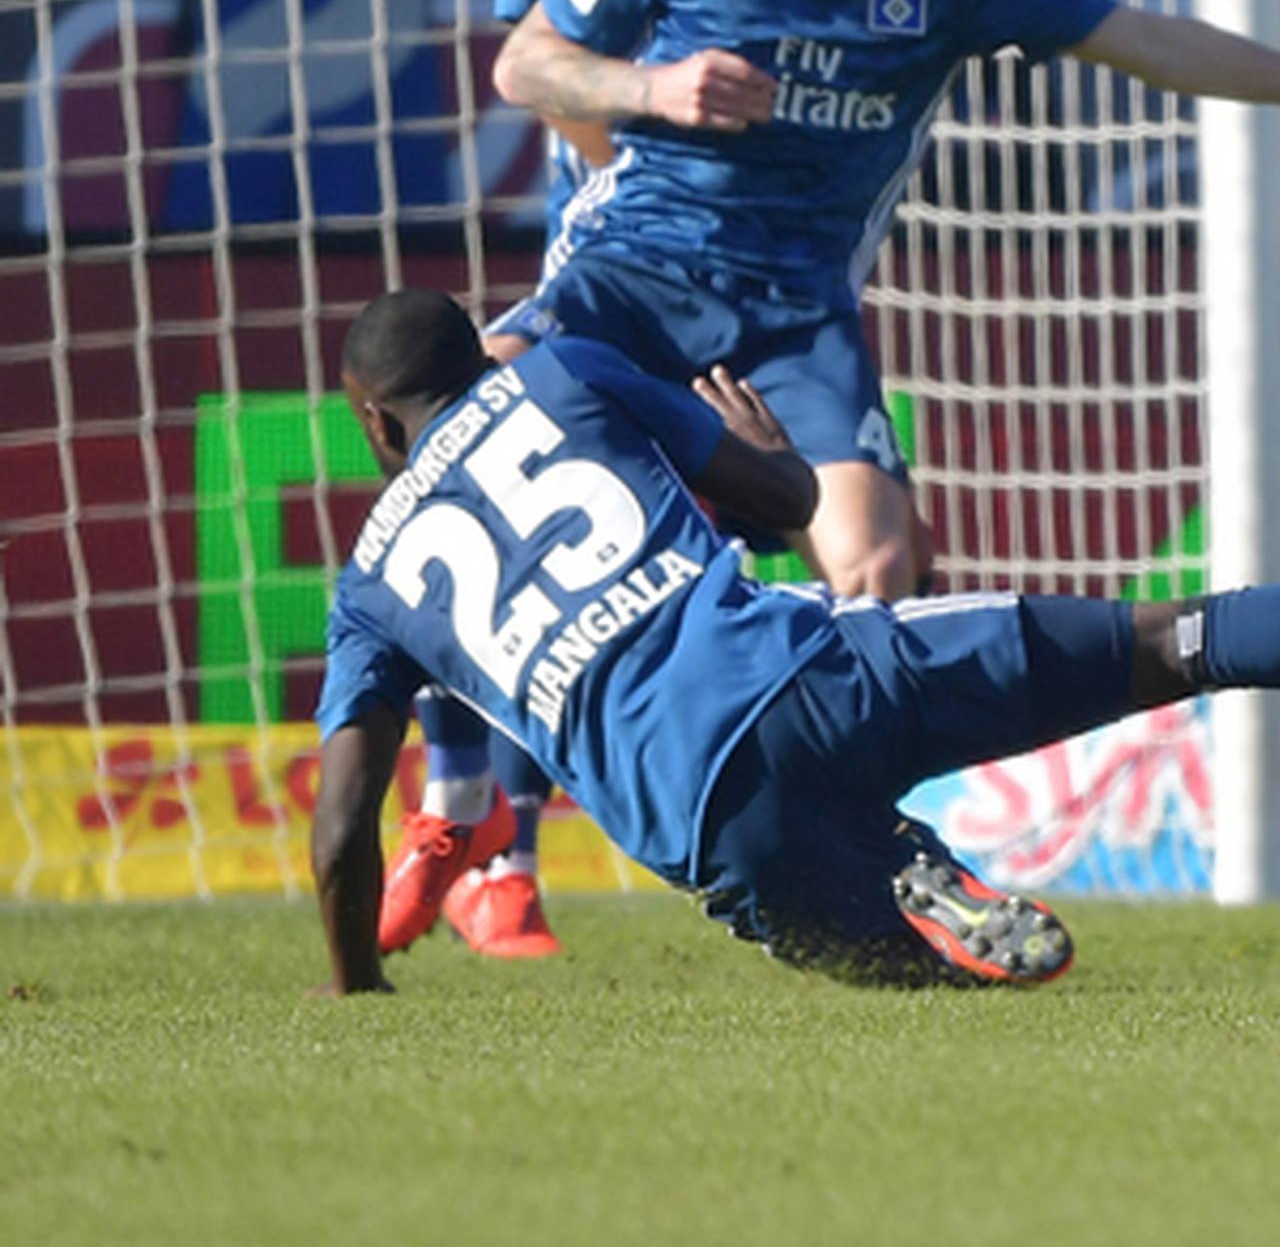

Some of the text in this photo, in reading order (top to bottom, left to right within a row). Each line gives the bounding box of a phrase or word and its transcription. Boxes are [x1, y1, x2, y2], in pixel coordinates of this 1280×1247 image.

[773, 72, 897, 131] irates
[774, 35, 843, 82] Fly
[353, 365, 525, 574] HAMBURGER SV
[383, 399, 648, 699] 25
[527, 548, 703, 735] MANGALA
